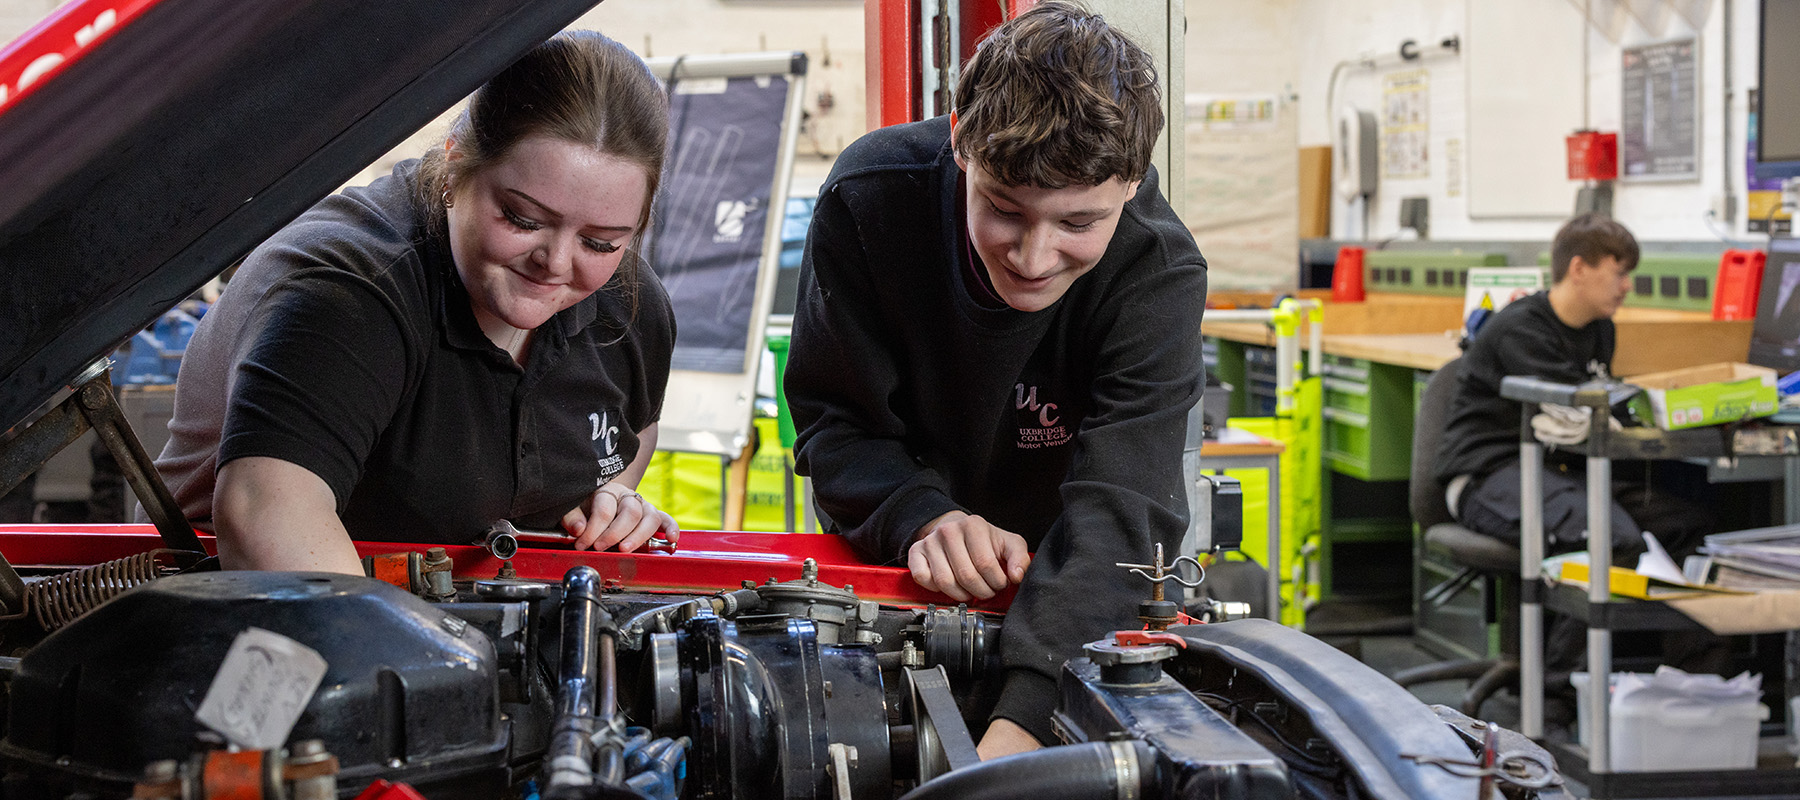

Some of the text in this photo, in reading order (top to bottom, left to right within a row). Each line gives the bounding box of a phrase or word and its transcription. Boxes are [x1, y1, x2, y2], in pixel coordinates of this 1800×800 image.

[1019, 426, 1066, 436] UXBRIDGE
[1021, 432, 1067, 442] COLLEGE
[1016, 441, 1041, 449] Motor
